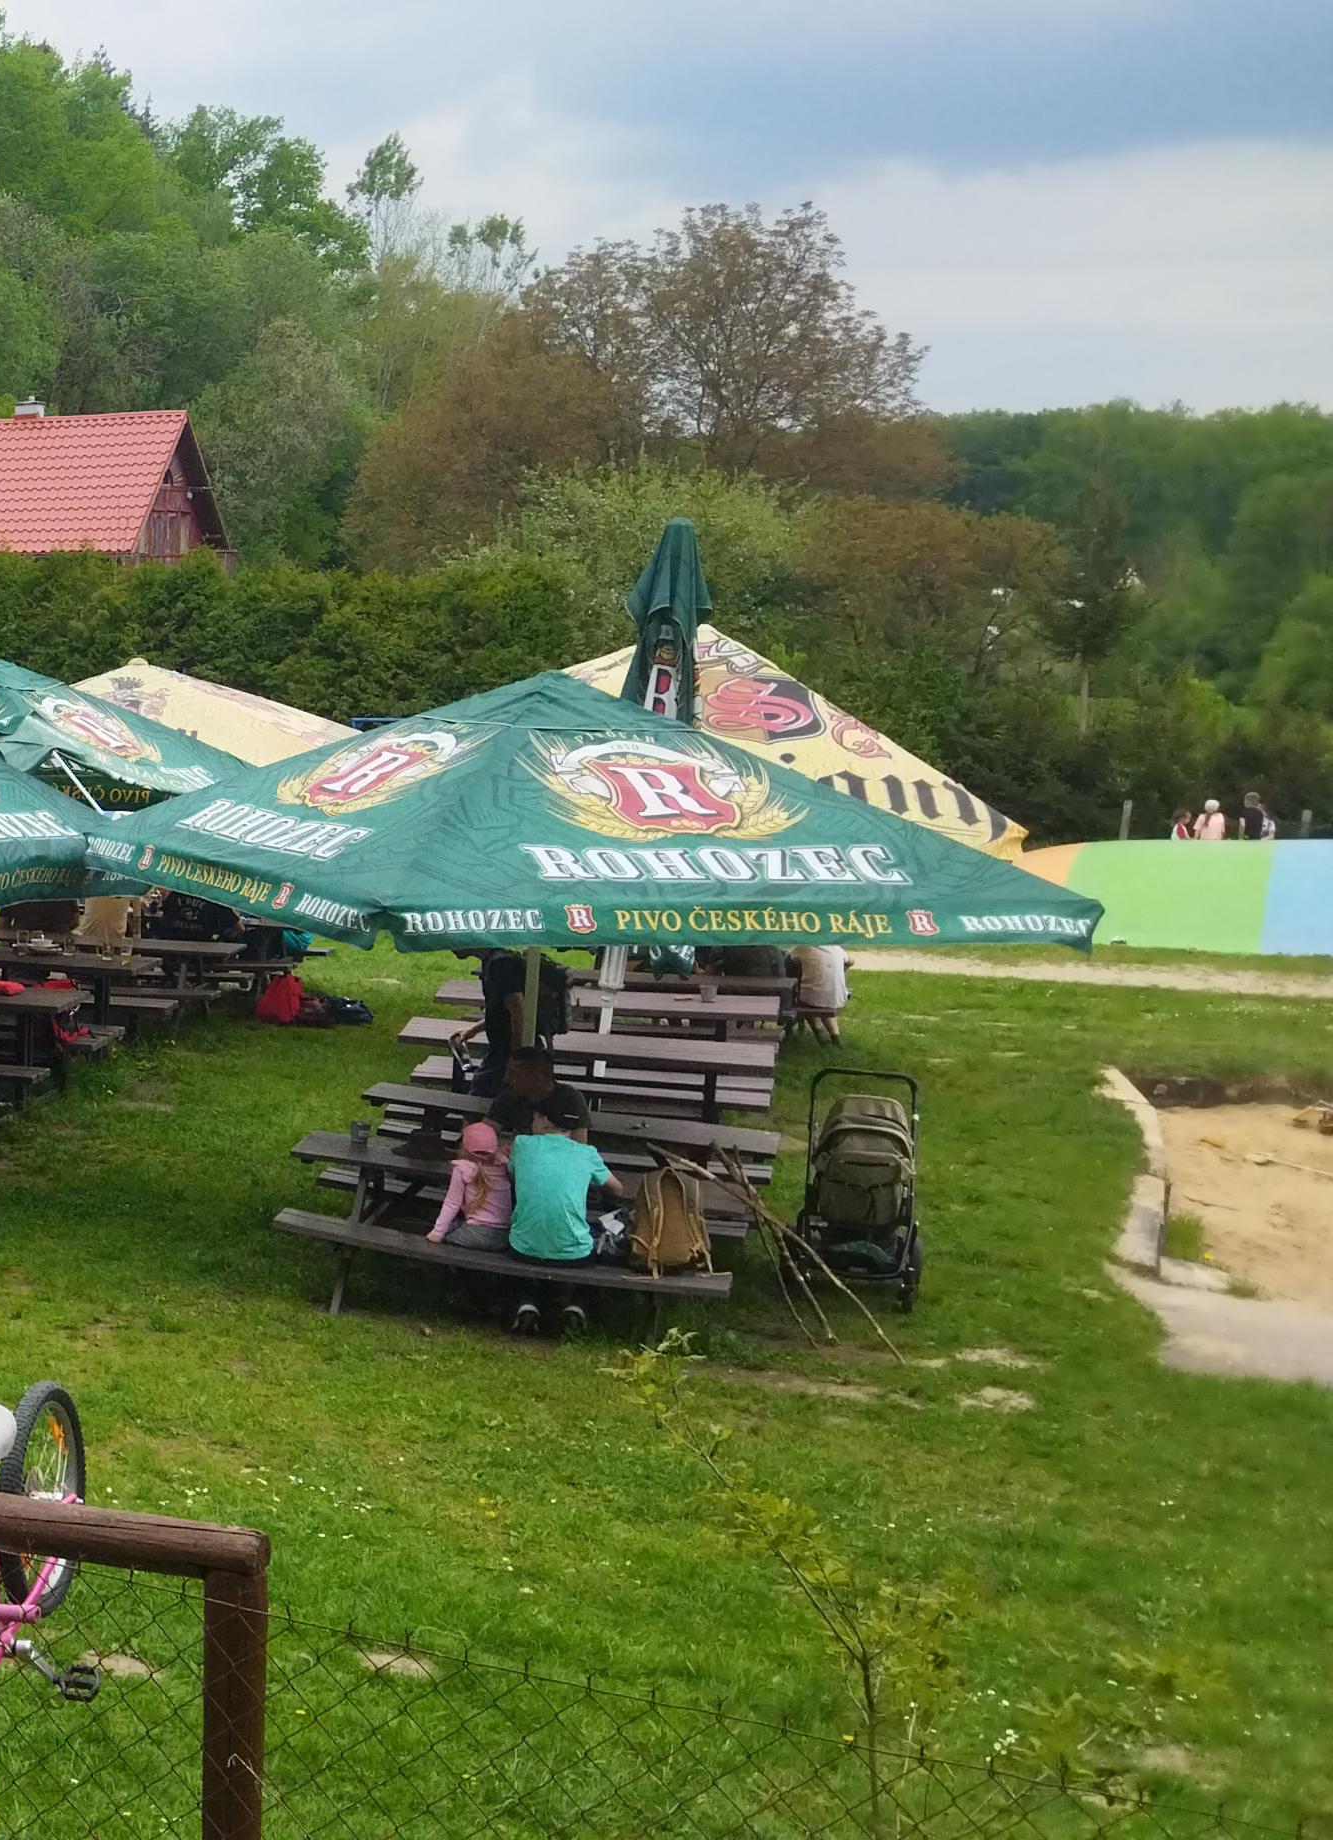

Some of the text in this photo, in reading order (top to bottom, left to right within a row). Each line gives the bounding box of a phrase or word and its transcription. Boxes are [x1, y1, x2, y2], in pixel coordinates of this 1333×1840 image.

[608, 766, 718, 817] R
[175, 799, 373, 861] ROHOZEC
[520, 844, 912, 887] ROHOZEC
[156, 854, 184, 878] PIVO
[185, 858, 242, 894] ČESKÉHO
[241, 876, 273, 904] RÁJE
[294, 892, 371, 934] ROHOZEC
[401, 909, 545, 935] ROHOZEC
[614, 909, 682, 931] PIVO
[688, 906, 821, 933] ČESKÉHO
[829, 906, 893, 939] RÁJE
[958, 914, 1092, 939] ROHOZEC
